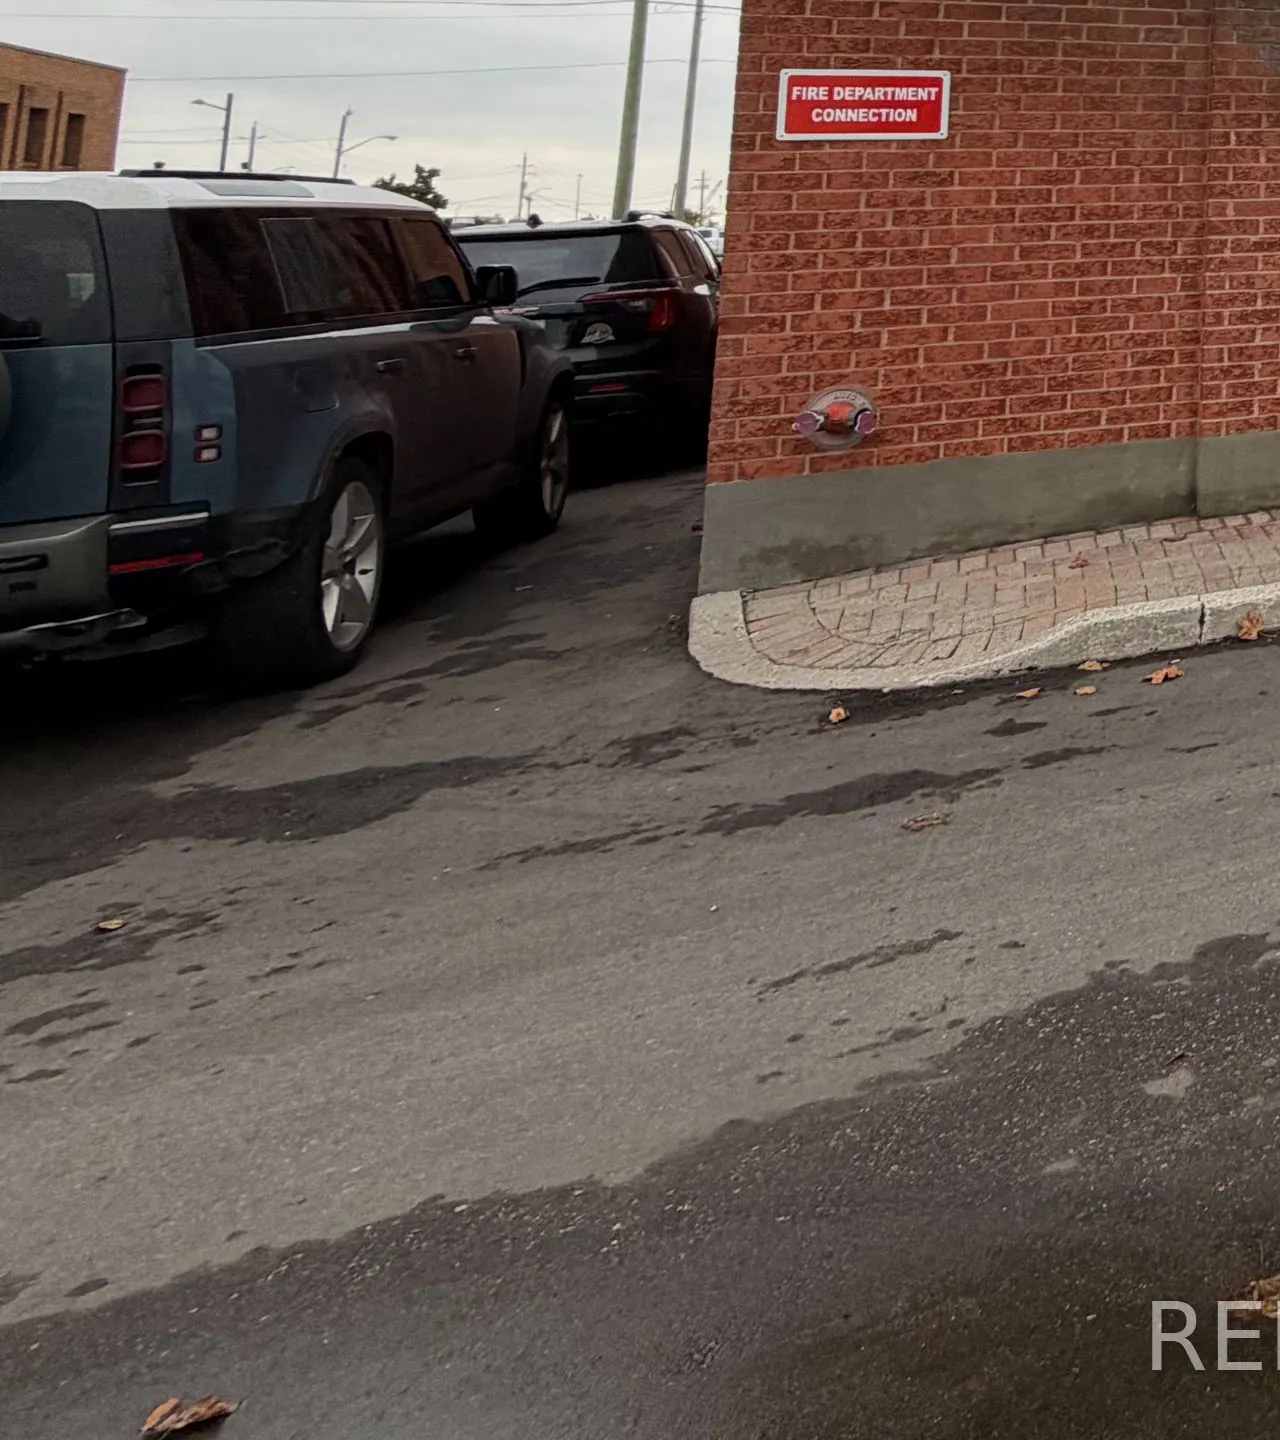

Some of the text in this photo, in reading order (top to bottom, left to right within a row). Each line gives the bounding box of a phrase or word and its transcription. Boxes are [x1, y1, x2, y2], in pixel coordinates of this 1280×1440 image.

[791, 86, 939, 101] FIRE DEPARTMENT
[811, 108, 918, 122] CONNECTION
